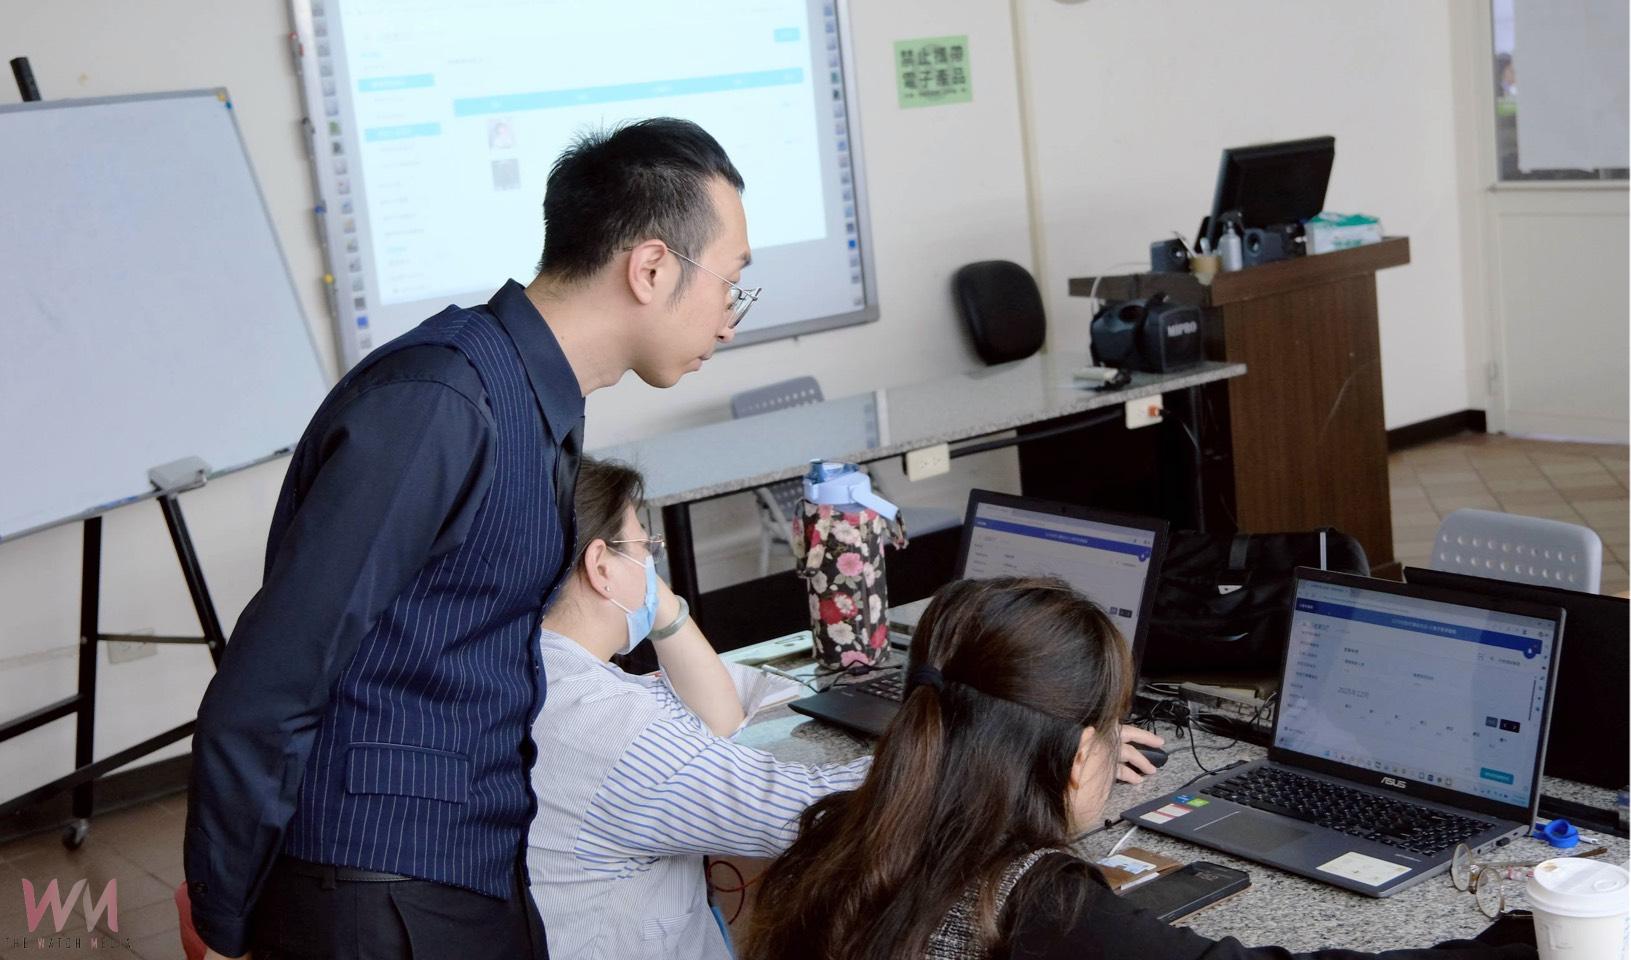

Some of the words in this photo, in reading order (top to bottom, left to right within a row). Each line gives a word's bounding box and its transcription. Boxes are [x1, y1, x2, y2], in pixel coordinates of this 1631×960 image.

[901, 45, 963, 66] 禁止攜帶
[903, 67, 966, 89] 電子產品
[1167, 321, 1197, 337] MIPRO
[1380, 776, 1407, 789] ASUS
